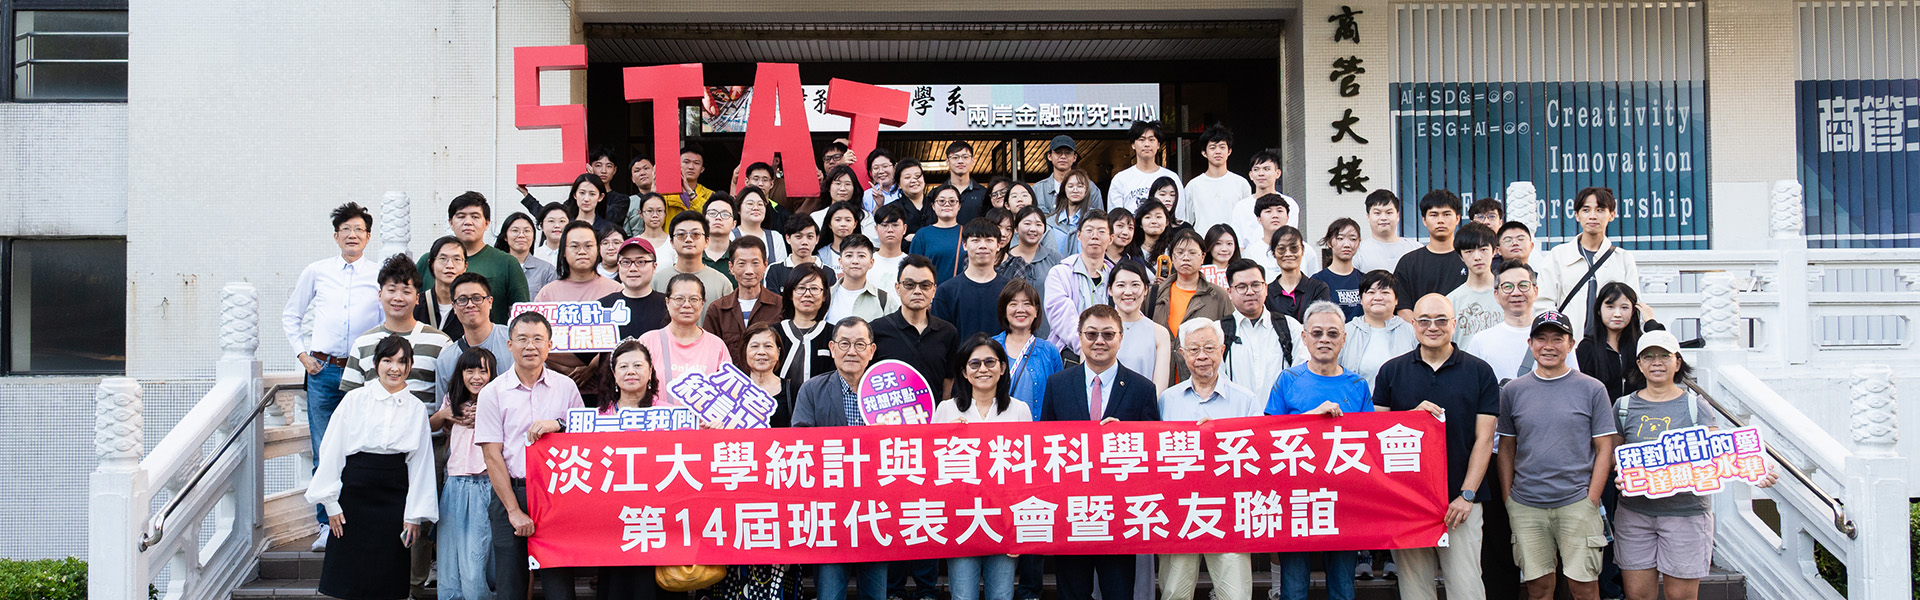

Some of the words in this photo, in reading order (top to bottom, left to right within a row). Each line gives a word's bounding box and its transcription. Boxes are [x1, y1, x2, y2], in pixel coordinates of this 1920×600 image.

[967, 103, 1157, 127] 兩岸金融研究中心
[1547, 99, 1690, 134] Creativity
[1550, 145, 1691, 173] Innovation
[545, 423, 1424, 495] 淡江大學統計與資料科學學系系友會
[1619, 428, 1761, 469] 我對統計的愛
[618, 488, 1340, 553] 第14屆班代表大會暨系友聯誼
